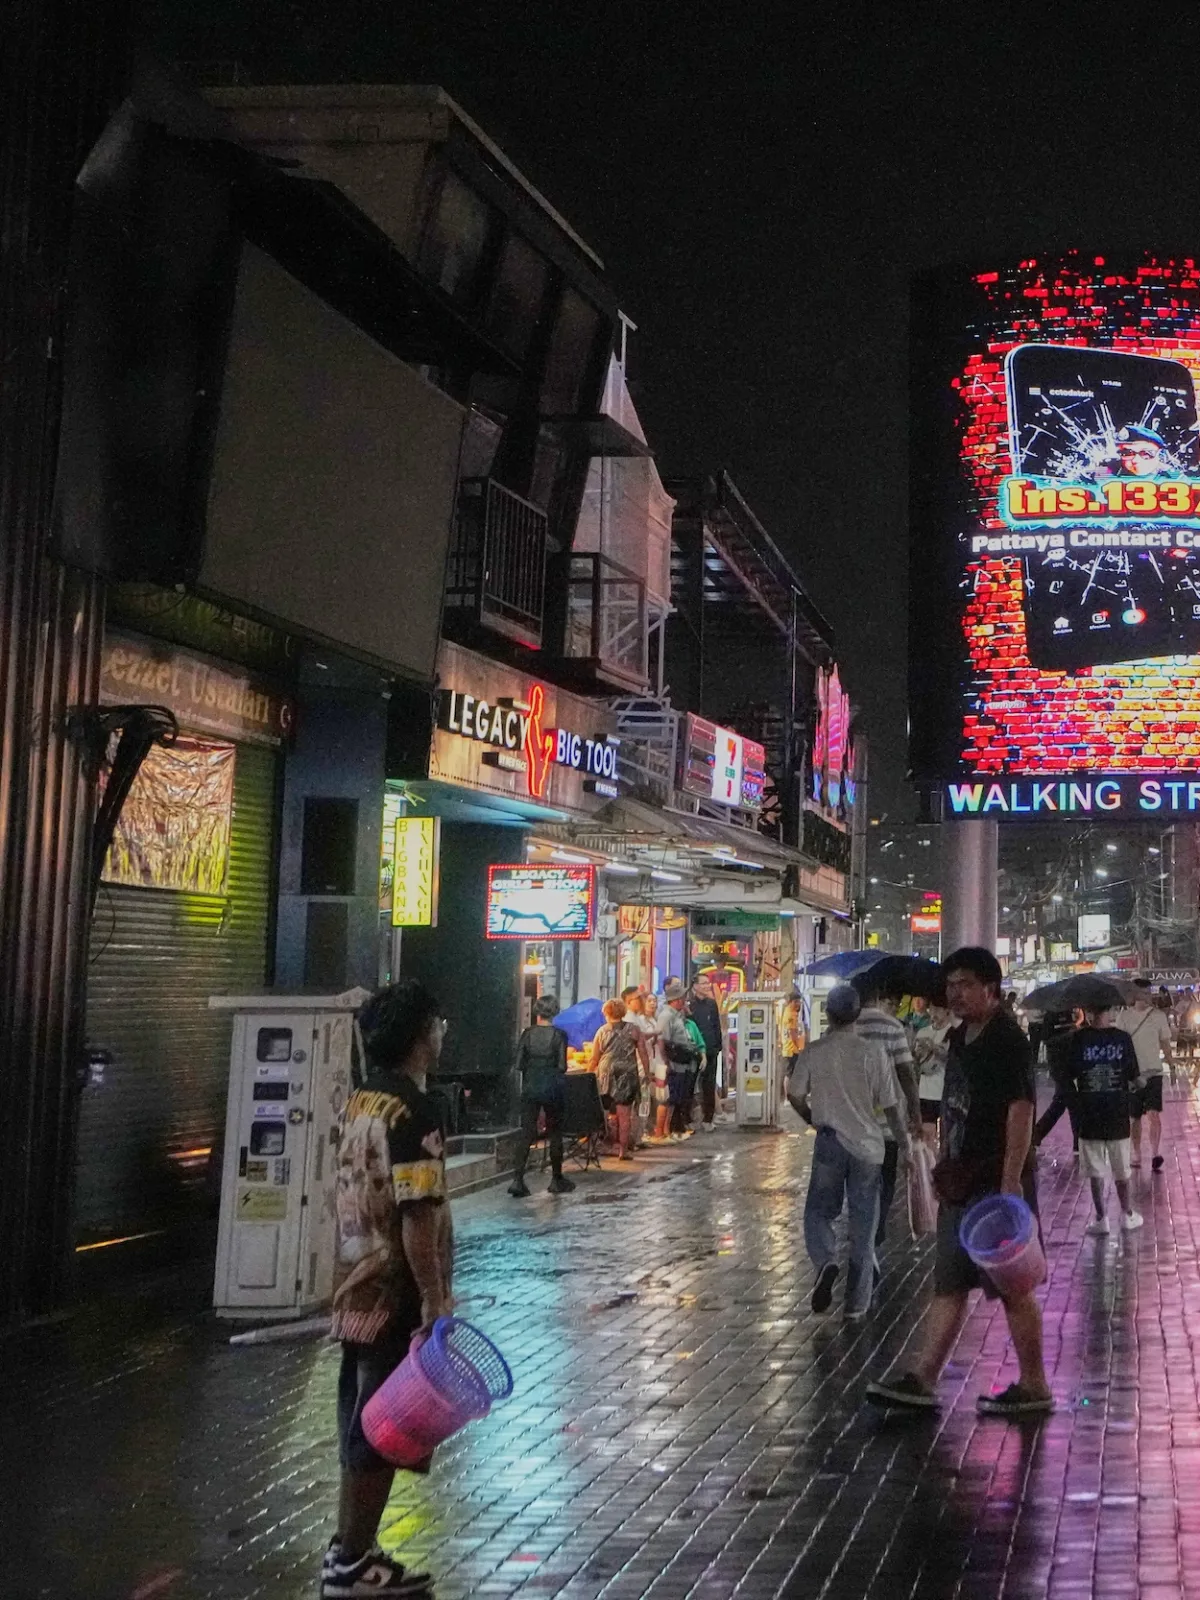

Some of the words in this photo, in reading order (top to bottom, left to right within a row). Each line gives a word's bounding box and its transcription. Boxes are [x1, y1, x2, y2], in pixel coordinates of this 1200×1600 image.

[972, 533, 1066, 553] Pattaya
[1070, 530, 1171, 548] Contact
[449, 690, 530, 750] LEGACY
[556, 728, 582, 768] BIG
[585, 739, 619, 780] TOOL
[948, 781, 1121, 812] WALKING
[510, 869, 567, 880] LEGACY
[1149, 971, 1194, 982] JALWA
